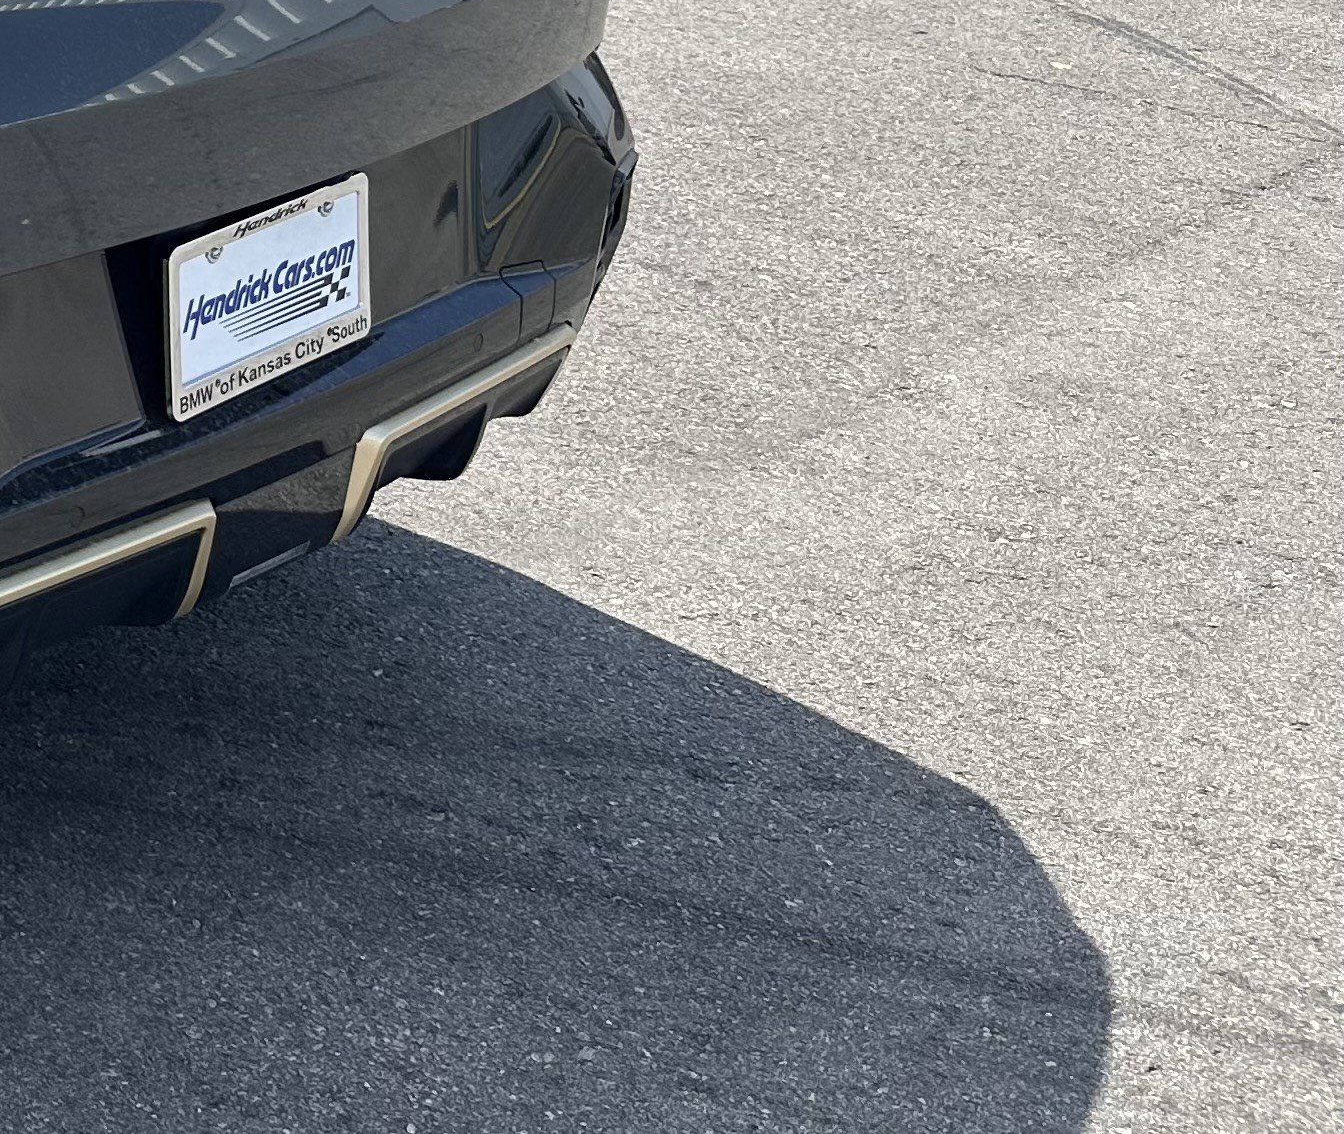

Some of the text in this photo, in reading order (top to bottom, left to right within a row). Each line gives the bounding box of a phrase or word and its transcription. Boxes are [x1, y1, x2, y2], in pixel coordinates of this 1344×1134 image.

[233, 198, 309, 239] Hendrick
[238, 350, 292, 388] Kansas
[295, 335, 324, 359] City
